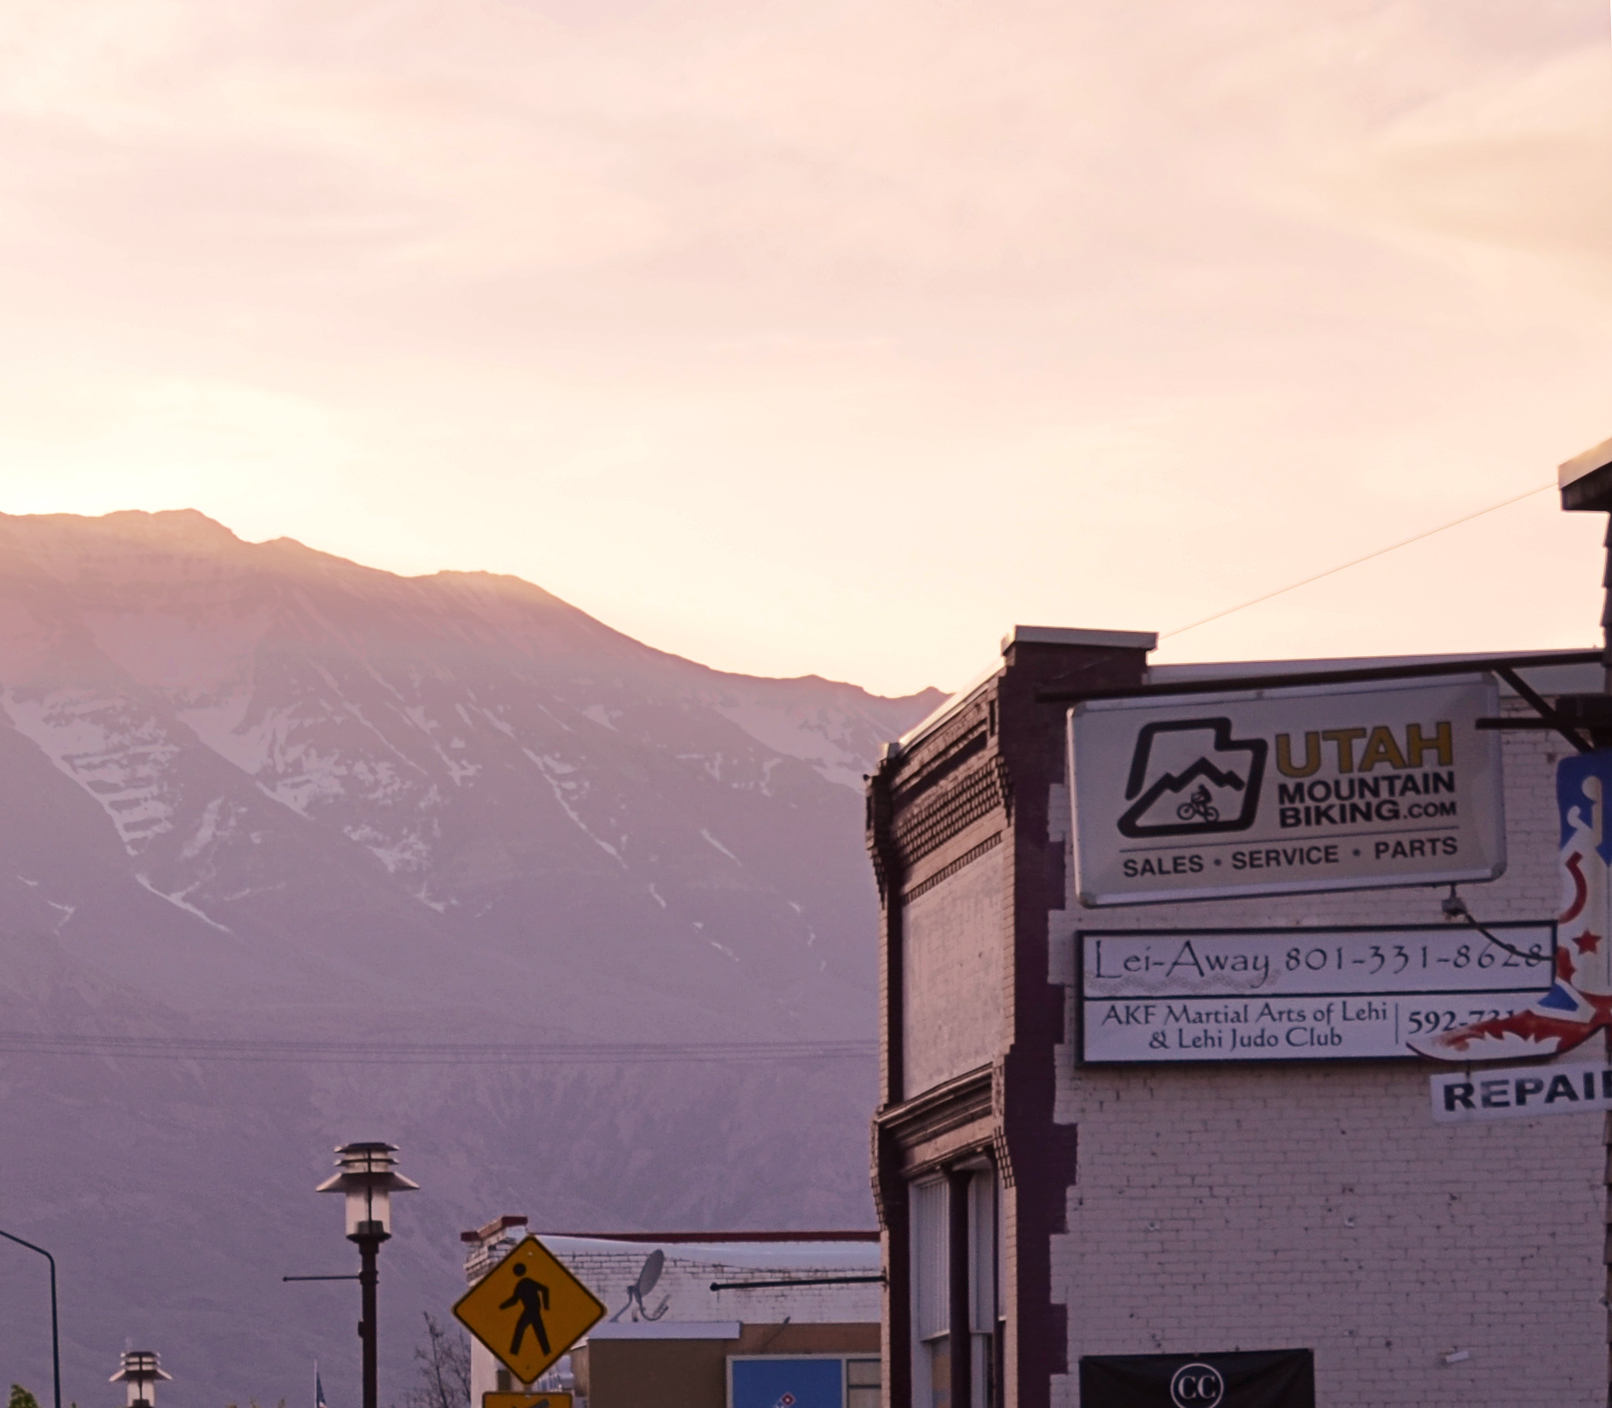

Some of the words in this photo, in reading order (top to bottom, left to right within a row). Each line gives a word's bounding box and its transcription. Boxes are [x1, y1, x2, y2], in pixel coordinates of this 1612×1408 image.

[1275, 721, 1453, 778] UTAH
[1278, 771, 1456, 805] MOUNTAIN
[1123, 854, 1205, 877] SALES
[1232, 844, 1339, 870] SERVICE
[1374, 836, 1459, 860] PARTS
[1094, 940, 1271, 988] Lei-Away
[1102, 1005, 1158, 1026] AKF
[1164, 1003, 1251, 1024] Martial
[1260, 1003, 1308, 1024] Arts
[1316, 1002, 1336, 1023] of
[1342, 1001, 1390, 1023] Lehi
[1149, 1031, 1169, 1050] &
[1178, 1030, 1224, 1049] Lehi
[1230, 1030, 1280, 1049] Judo
[1286, 1026, 1343, 1048] Club
[1178, 1376, 1216, 1399] CC
